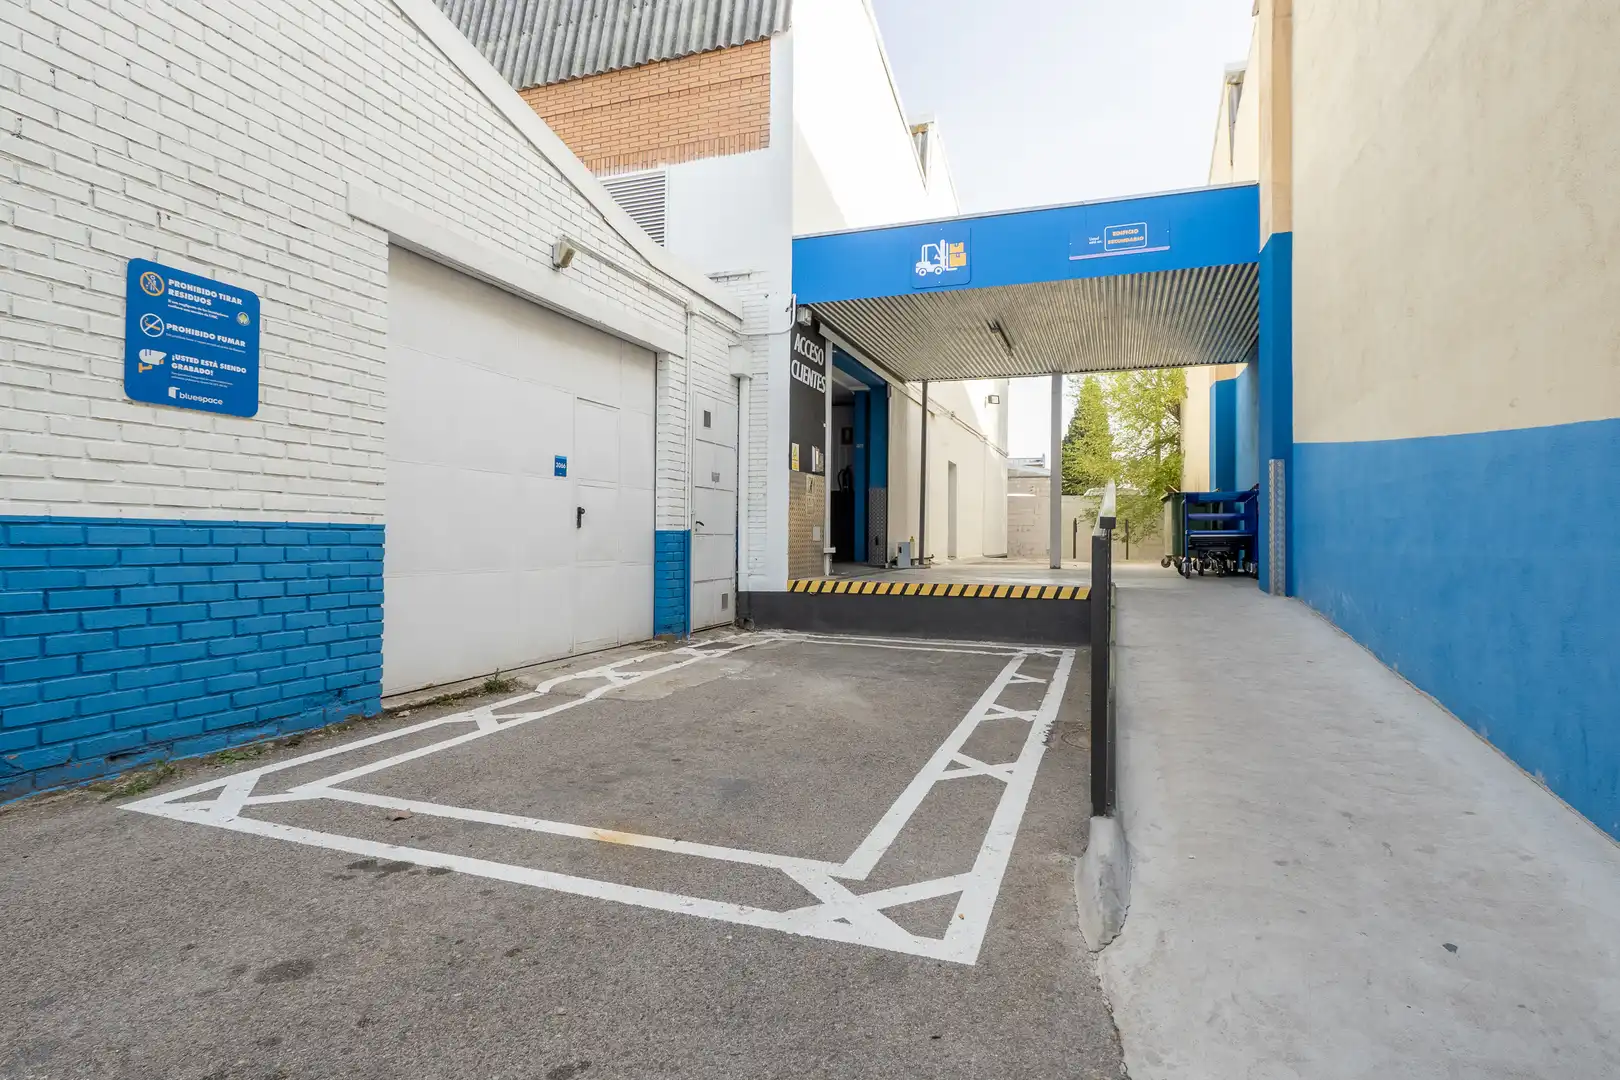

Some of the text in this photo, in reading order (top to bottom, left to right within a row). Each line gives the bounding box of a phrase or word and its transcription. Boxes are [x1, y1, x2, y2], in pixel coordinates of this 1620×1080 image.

[168, 279, 243, 306] PROHIBIDO TIRAR
[168, 288, 212, 306] RESIDUOS
[166, 323, 216, 340] PROHIBIDO
[217, 334, 246, 347] FUMAR
[794, 333, 824, 366] ACCESO
[171, 354, 247, 374] ¡USTED ESTÁ SIENDO
[171, 363, 214, 376] GRABADO!
[791, 359, 826, 393] CLIENTES
[179, 391, 224, 405] bluespace
